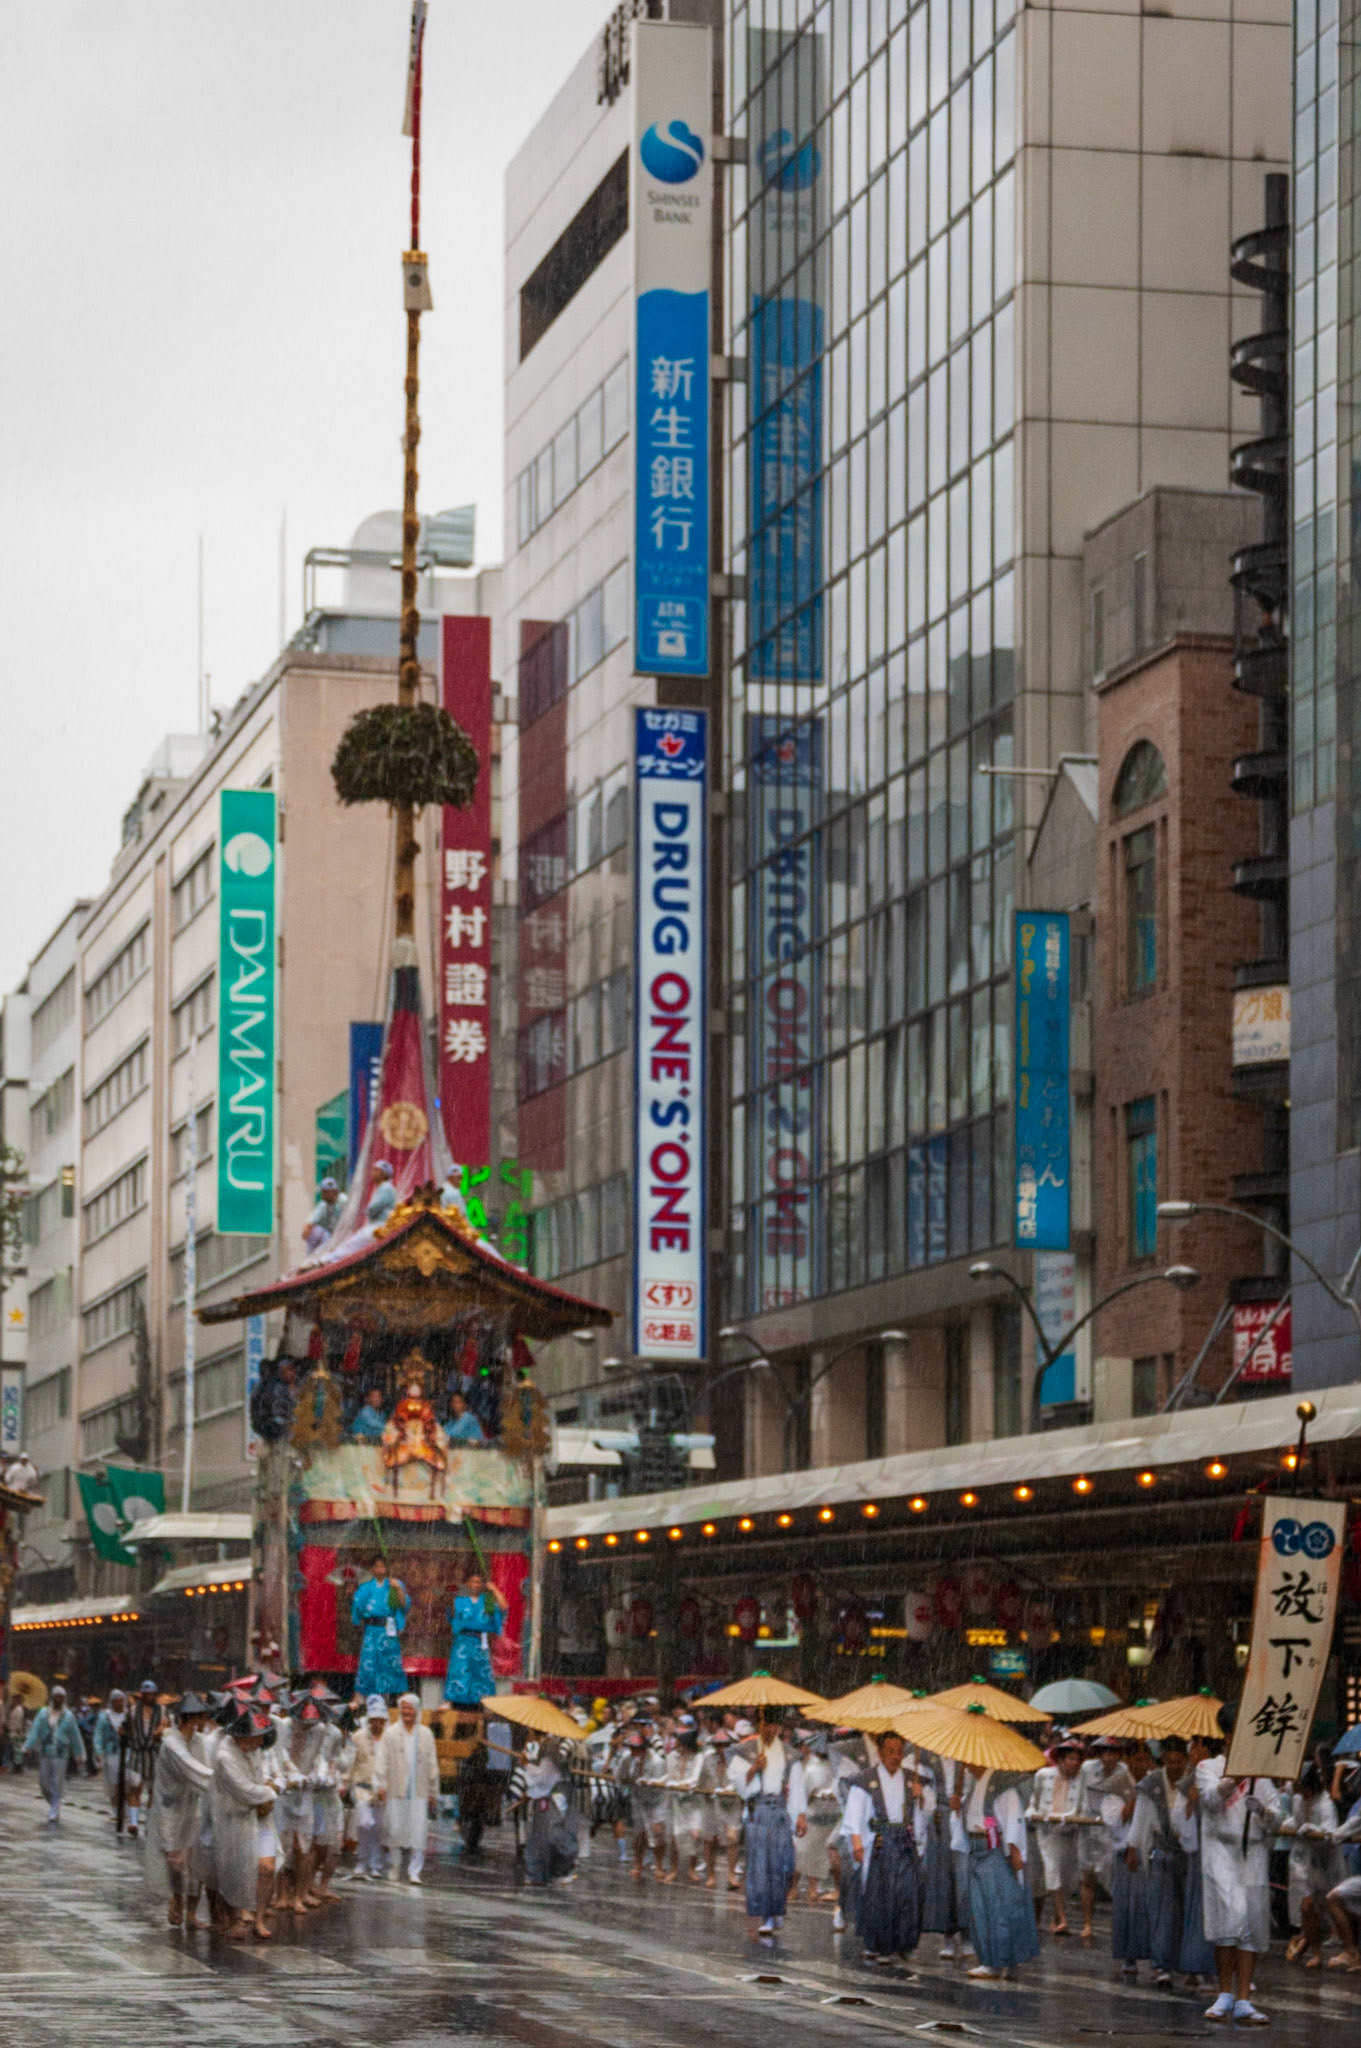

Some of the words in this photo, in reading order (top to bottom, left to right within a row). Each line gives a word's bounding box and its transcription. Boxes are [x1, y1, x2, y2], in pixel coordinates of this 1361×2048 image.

[653, 209, 693, 225] BANK
[650, 355, 695, 551] 新生銀行
[637, 754, 705, 777] チェーン
[644, 710, 698, 733] セガミ
[653, 802, 690, 955] DRUG
[445, 849, 488, 1064] 野村證券
[225, 908, 267, 1190] DAIMARU
[647, 1284, 693, 1306] くすり
[1249, 1570, 1324, 1755] 放下鉾
